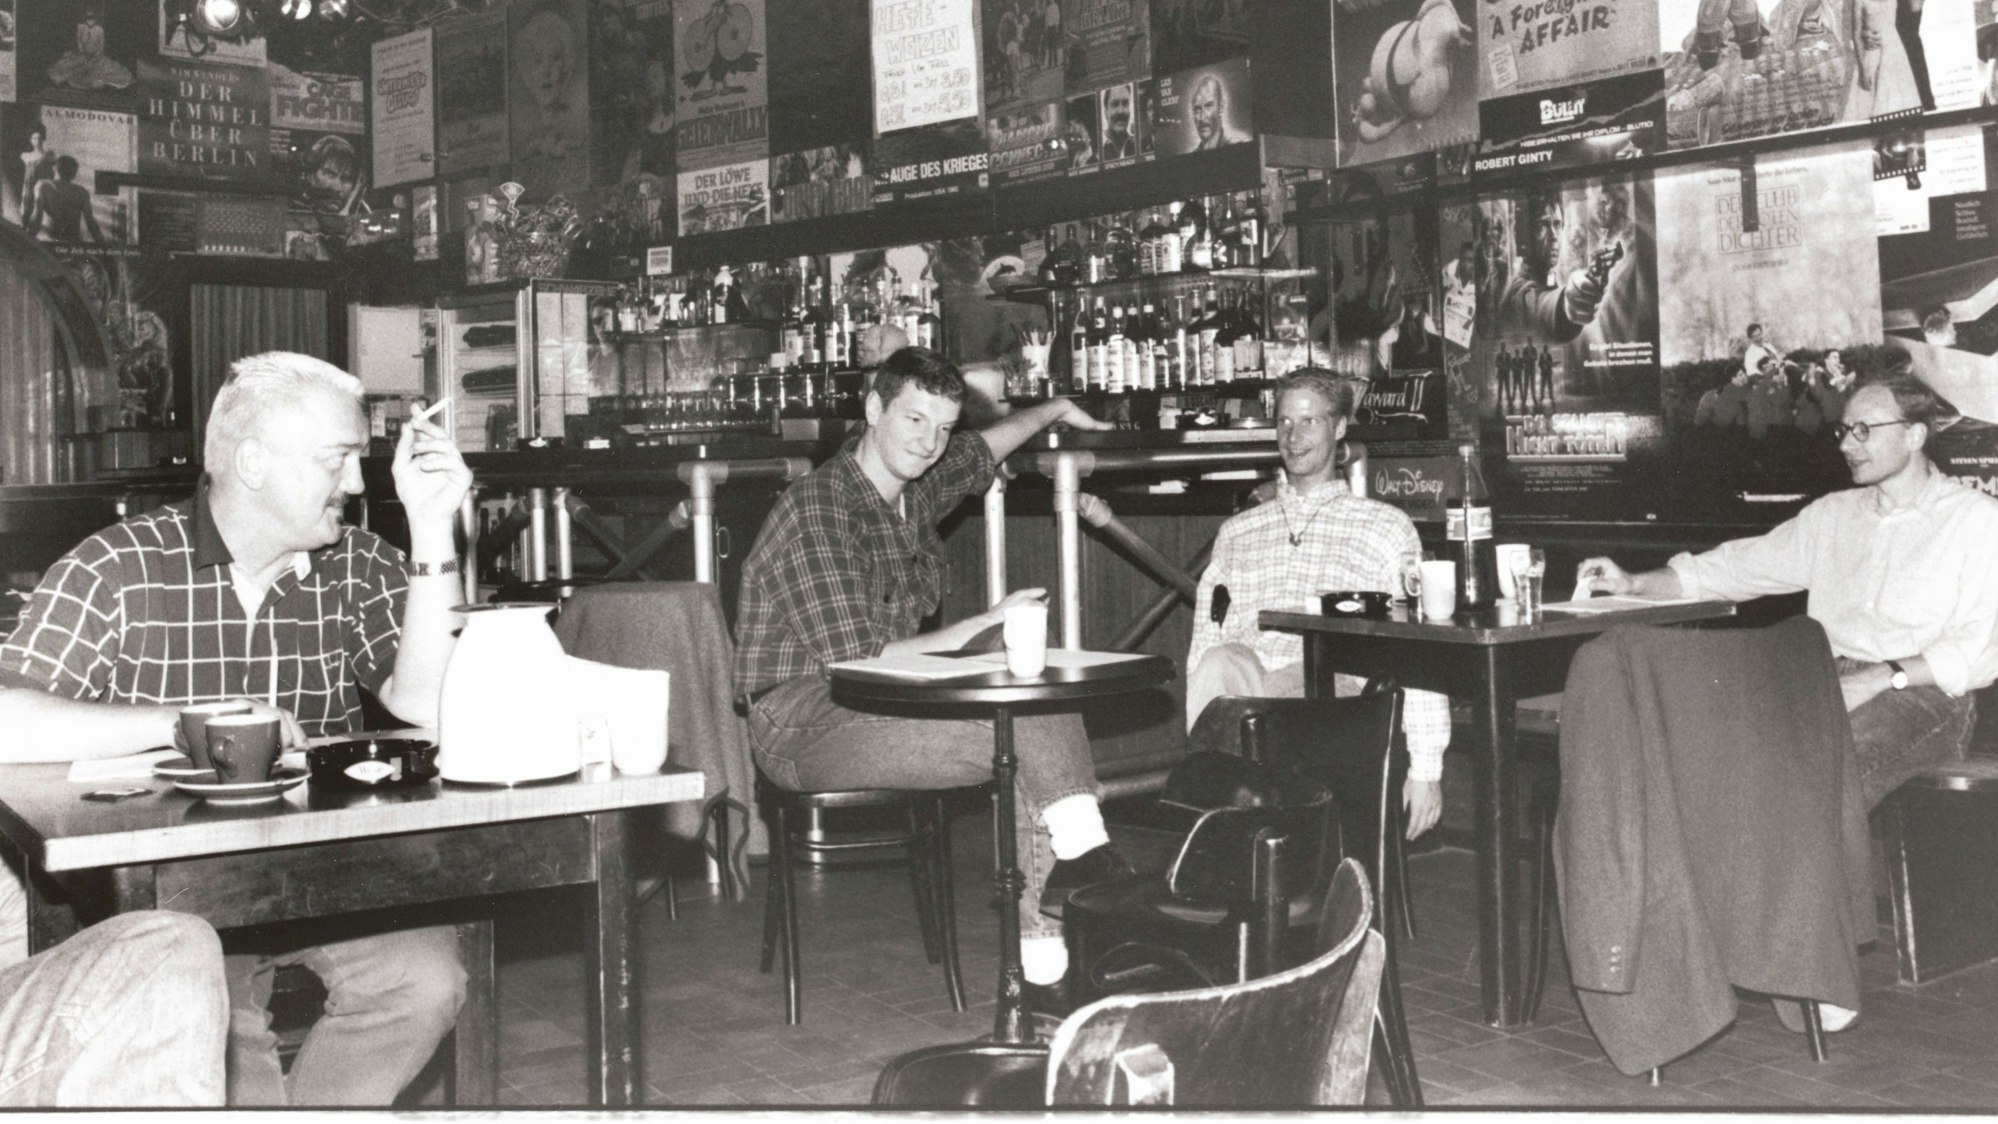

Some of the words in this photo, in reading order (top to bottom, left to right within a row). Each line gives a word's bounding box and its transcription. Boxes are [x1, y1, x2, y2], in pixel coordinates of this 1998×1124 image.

[1510, 0, 1585, 32] Foreig
[885, 25, 960, 65] WEIZEN
[179, 81, 232, 103] DER
[149, 97, 263, 127] HIMMEL
[169, 117, 243, 146] ÜBER
[153, 141, 258, 168] BERLIN
[889, 167, 919, 184] AUGE
[920, 160, 941, 181] DES
[943, 152, 988, 176] KRIEGES
[1475, 154, 1517, 172] ROBERT
[1517, 150, 1554, 166] GINTY
[695, 173, 717, 189] DER
[719, 166, 752, 187] LÖWE
[711, 187, 731, 203] DIE
[1719, 222, 1800, 252] DICHTER
